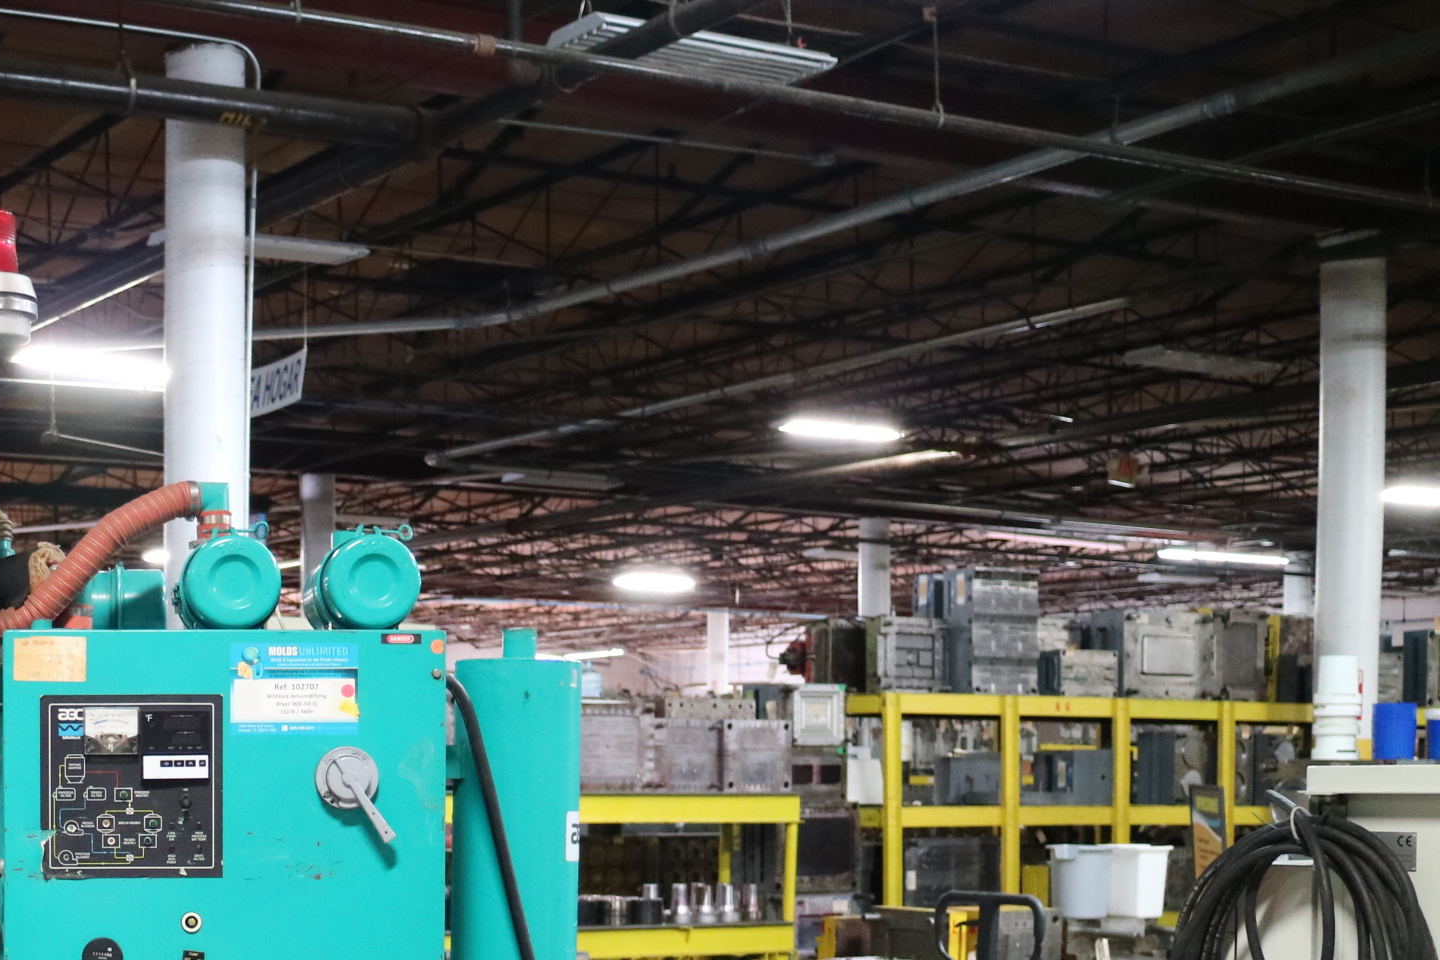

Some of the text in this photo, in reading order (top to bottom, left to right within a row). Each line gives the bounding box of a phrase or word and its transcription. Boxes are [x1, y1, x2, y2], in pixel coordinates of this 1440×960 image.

[262, 358, 302, 407] HOGAR
[268, 646, 349, 656] MOLDS UNLIMITED
[1397, 835, 1412, 847] CE
